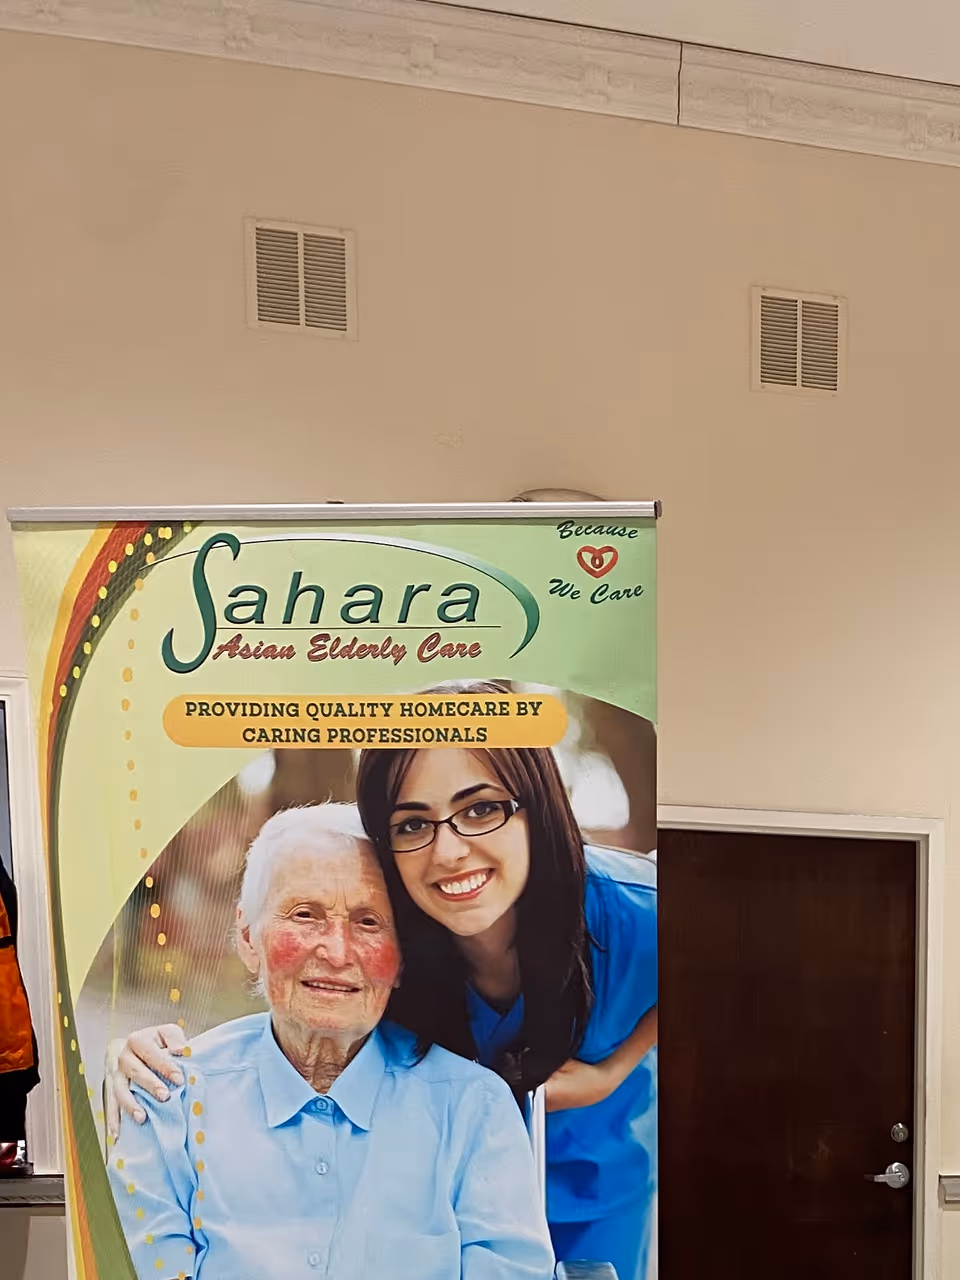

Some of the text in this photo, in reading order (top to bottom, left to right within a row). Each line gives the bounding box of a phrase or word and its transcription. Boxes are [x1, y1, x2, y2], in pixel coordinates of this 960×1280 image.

[557, 519, 639, 540] Because
[162, 532, 481, 673] Sahara
[549, 577, 644, 604] We Care
[212, 632, 482, 666] Asian Elderly Care
[186, 702, 542, 721] PROVIDING QUALITY HOMECARE BY
[243, 728, 487, 743] CARING PROFESSIONALS
